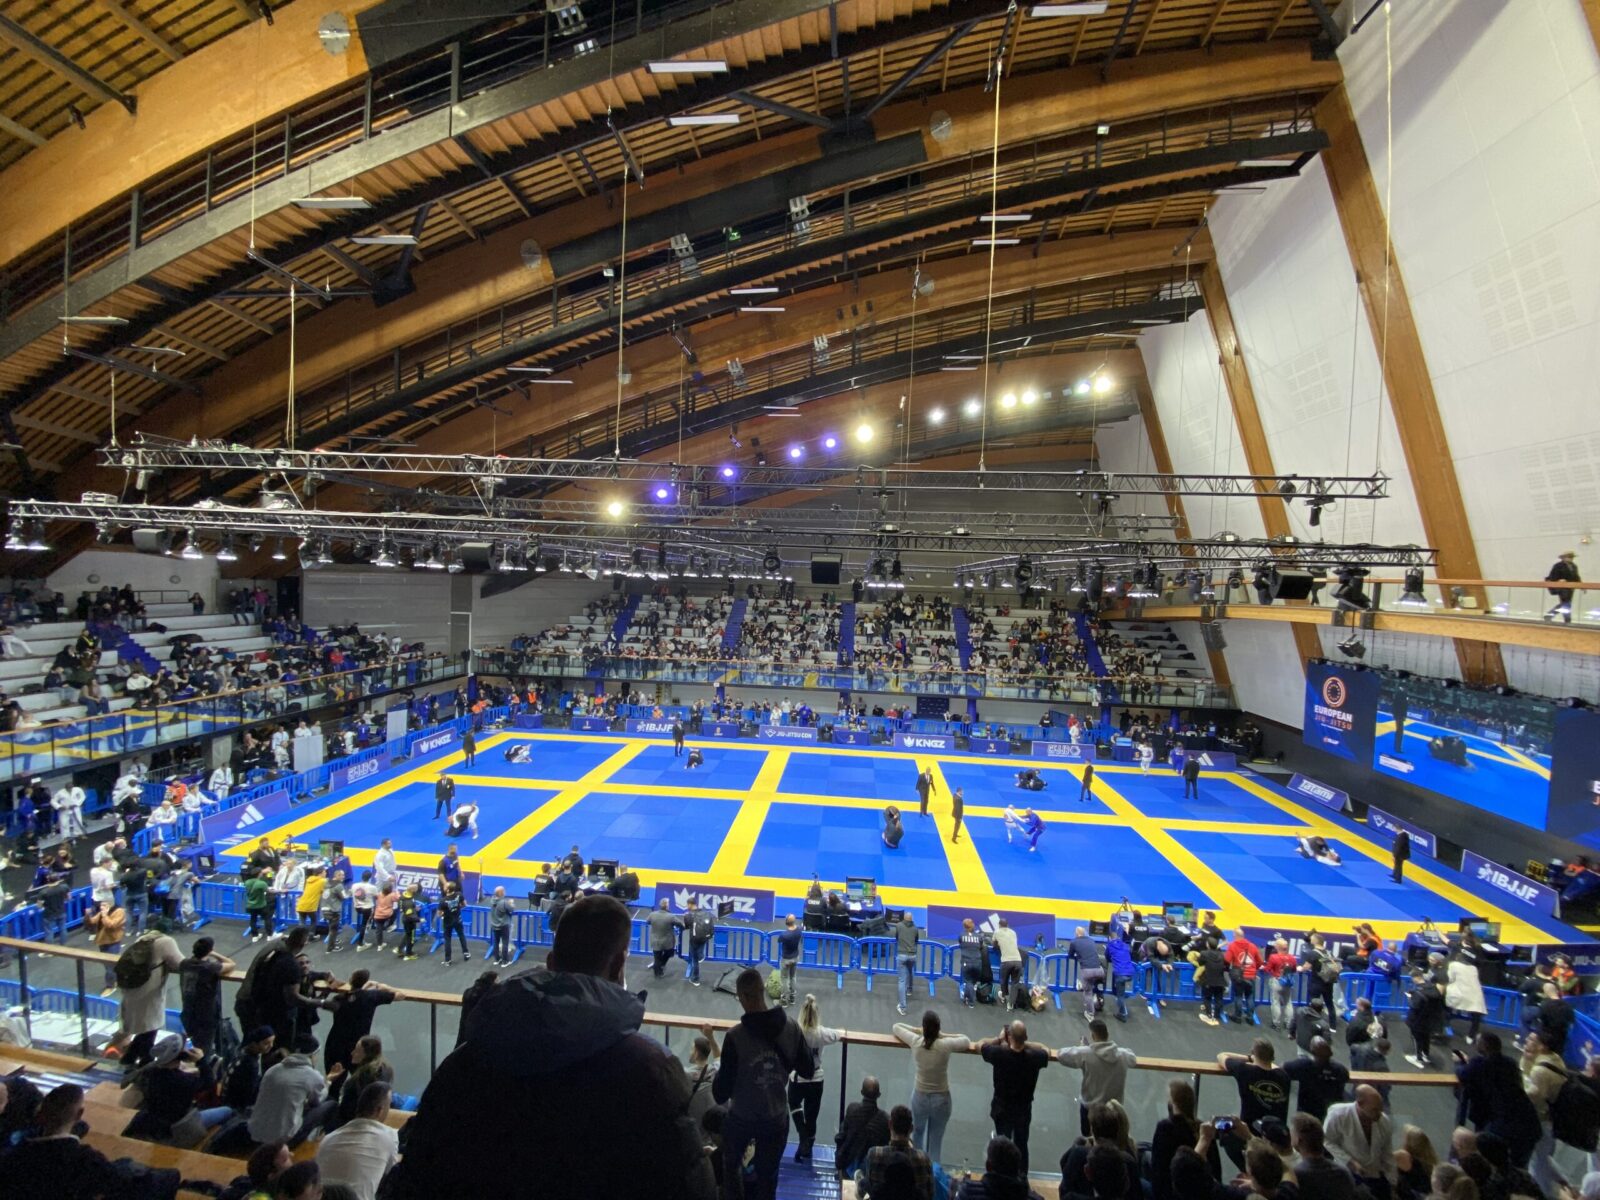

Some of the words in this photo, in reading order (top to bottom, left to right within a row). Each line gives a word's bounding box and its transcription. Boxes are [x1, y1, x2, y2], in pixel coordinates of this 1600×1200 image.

[1314, 705, 1353, 722] EUROPEAN
[646, 723, 674, 732] IBJJF
[915, 738, 945, 749] KNGZ
[1491, 870, 1539, 900] IBJJF
